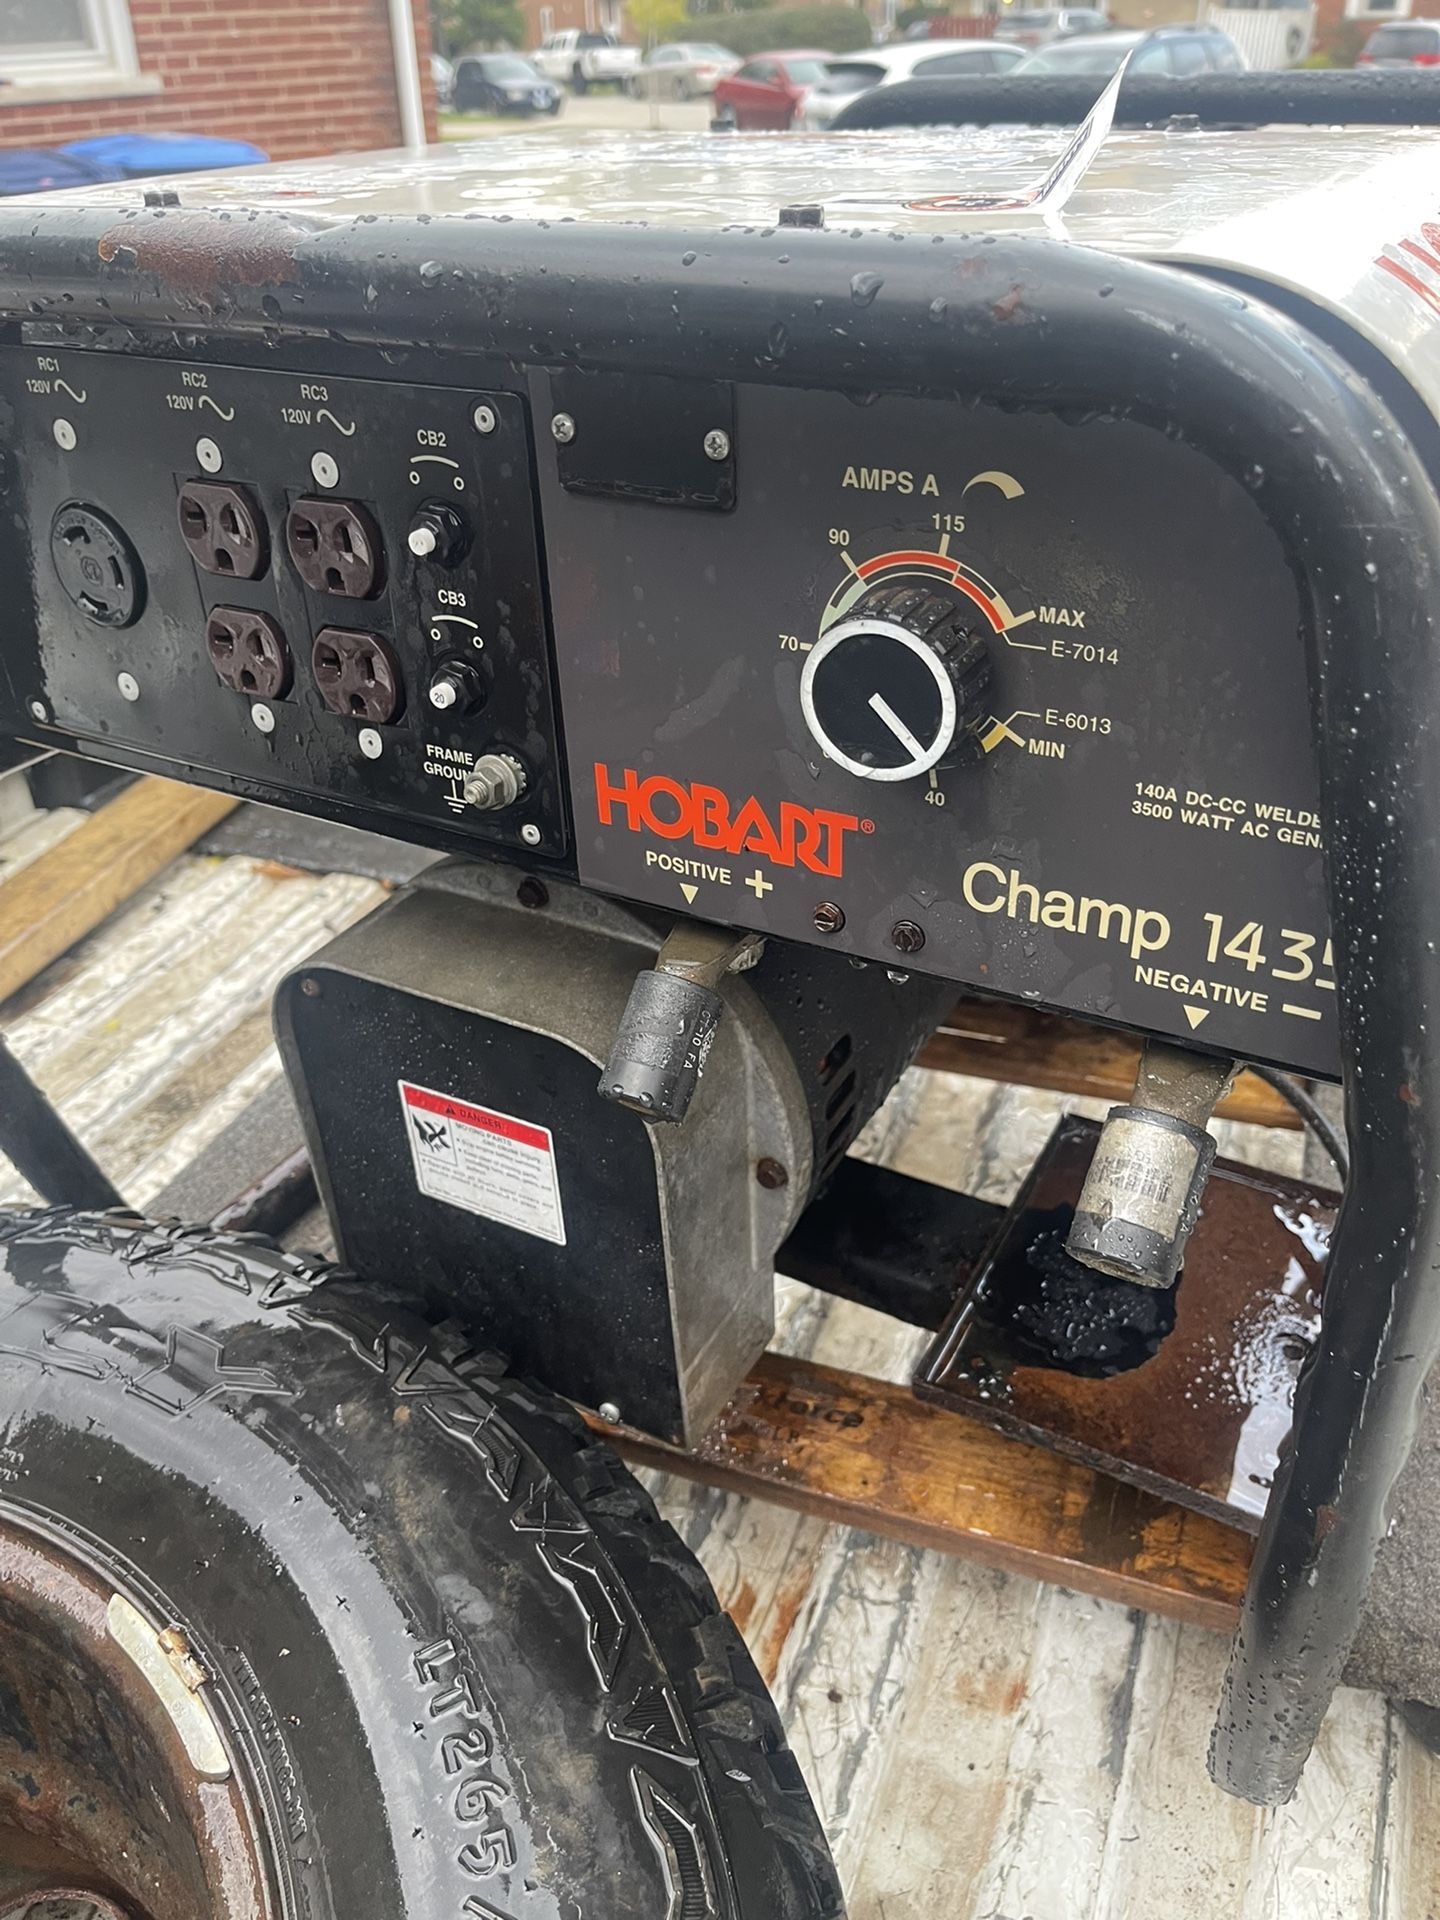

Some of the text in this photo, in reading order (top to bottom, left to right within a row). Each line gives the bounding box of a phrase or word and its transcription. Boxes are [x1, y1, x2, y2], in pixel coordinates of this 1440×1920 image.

[37, 357, 60, 372] RC1
[26, 379, 51, 394] 120V
[182, 372, 208, 388] RC2
[166, 394, 194, 411] 120V
[300, 384, 329, 401] RC3
[281, 407, 312, 425] 120V
[417, 429, 447, 448] CB2
[842, 466, 940, 497] AMPS A
[932, 513, 965, 533] 115
[828, 529, 850, 546] 90
[438, 589, 466, 607] CB3
[1038, 606, 1086, 628] MAX
[778, 634, 799, 651] 70
[1051, 641, 1119, 665] E-7014
[434, 692, 445, 704] 20
[1045, 709, 1112, 734] E-6013
[426, 744, 474, 766] FRAME
[1029, 739, 1065, 759] MIN
[924, 790, 945, 807] 40
[1135, 781, 1177, 803] 140A
[1186, 791, 1247, 815] DC-CC
[1131, 800, 1173, 820] 3500
[1180, 808, 1235, 832] WATT
[1240, 821, 1269, 839] AC
[645, 850, 732, 886] POSITIVE
[962, 861, 1171, 960] Champ
[1134, 965, 1269, 1013] NEGATIVE
[459, 1108, 502, 1130] DANGER
